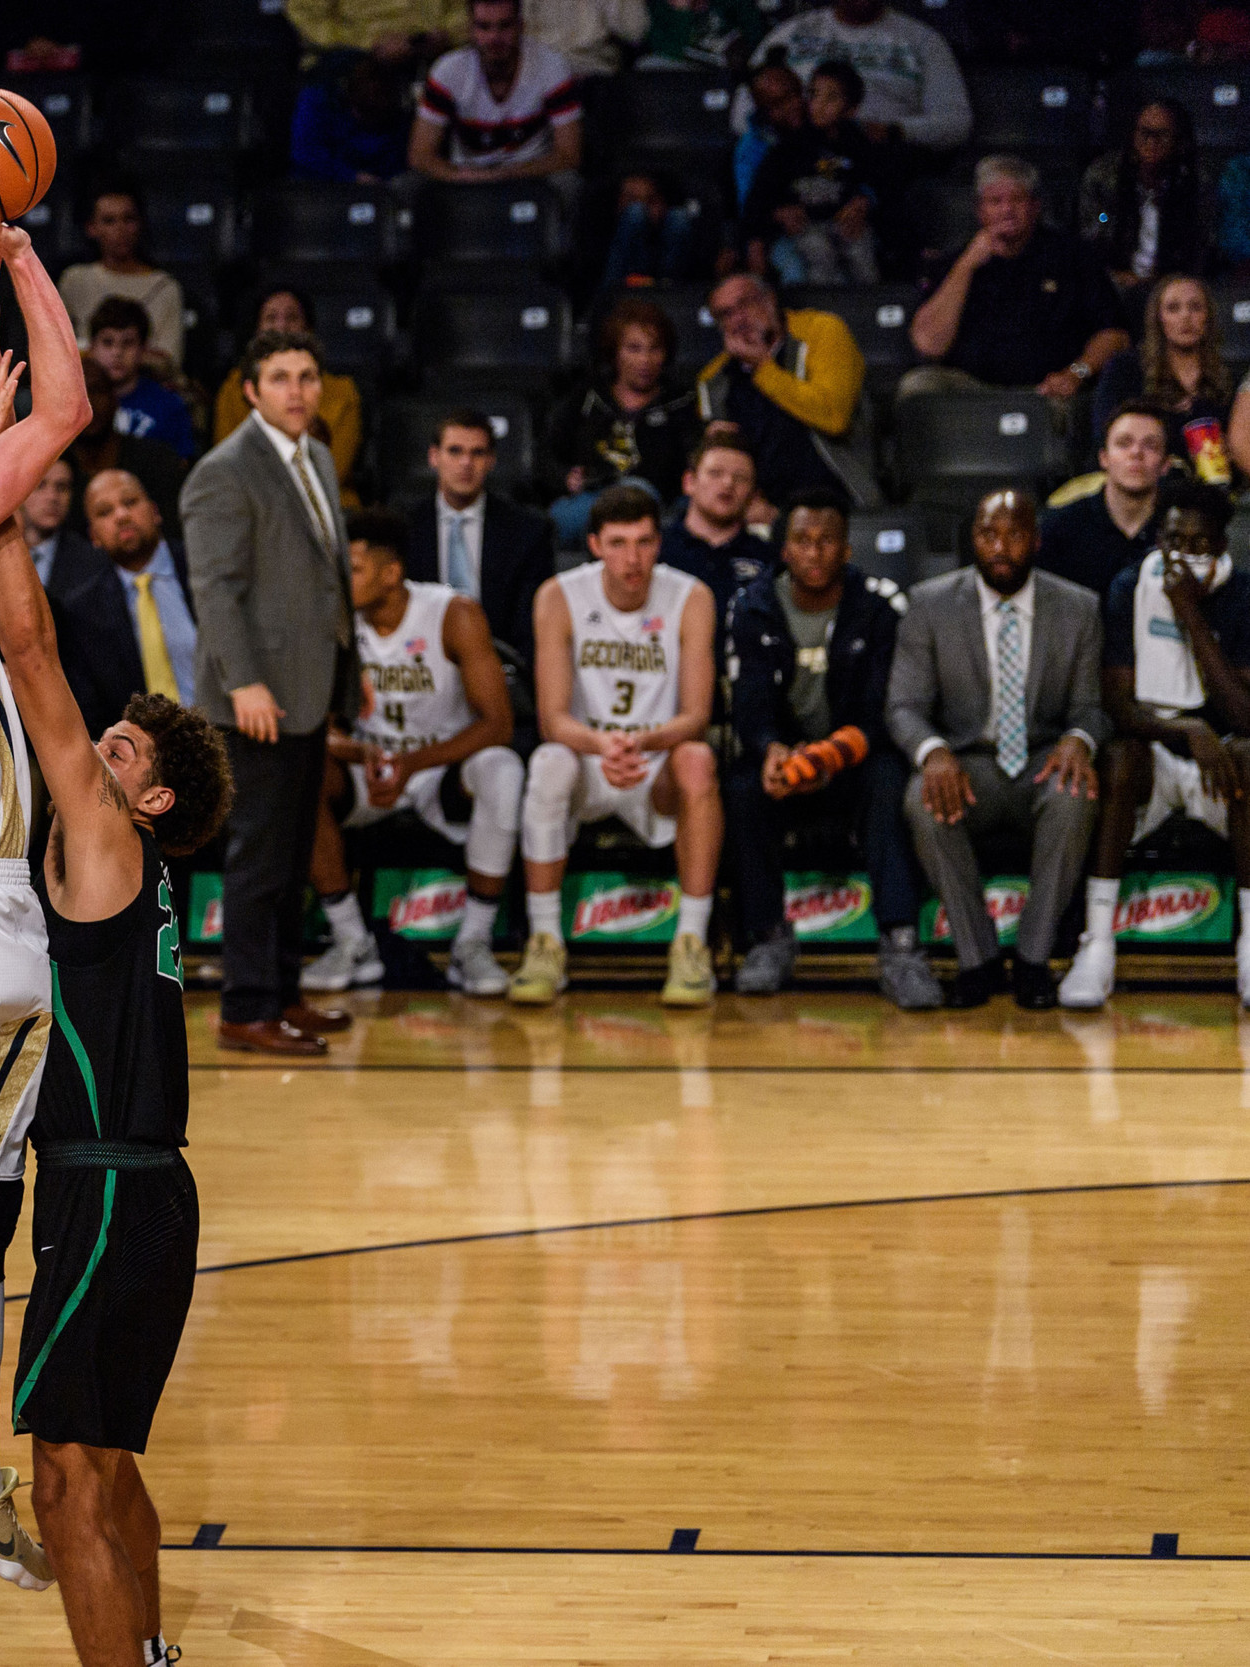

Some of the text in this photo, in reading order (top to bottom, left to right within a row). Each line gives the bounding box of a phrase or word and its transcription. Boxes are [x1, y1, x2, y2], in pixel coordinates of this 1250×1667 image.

[384, 702, 405, 732] 4
[611, 680, 636, 716] 3
[572, 888, 675, 938] LIBMAN
[1112, 887, 1213, 934] LIBMAN
